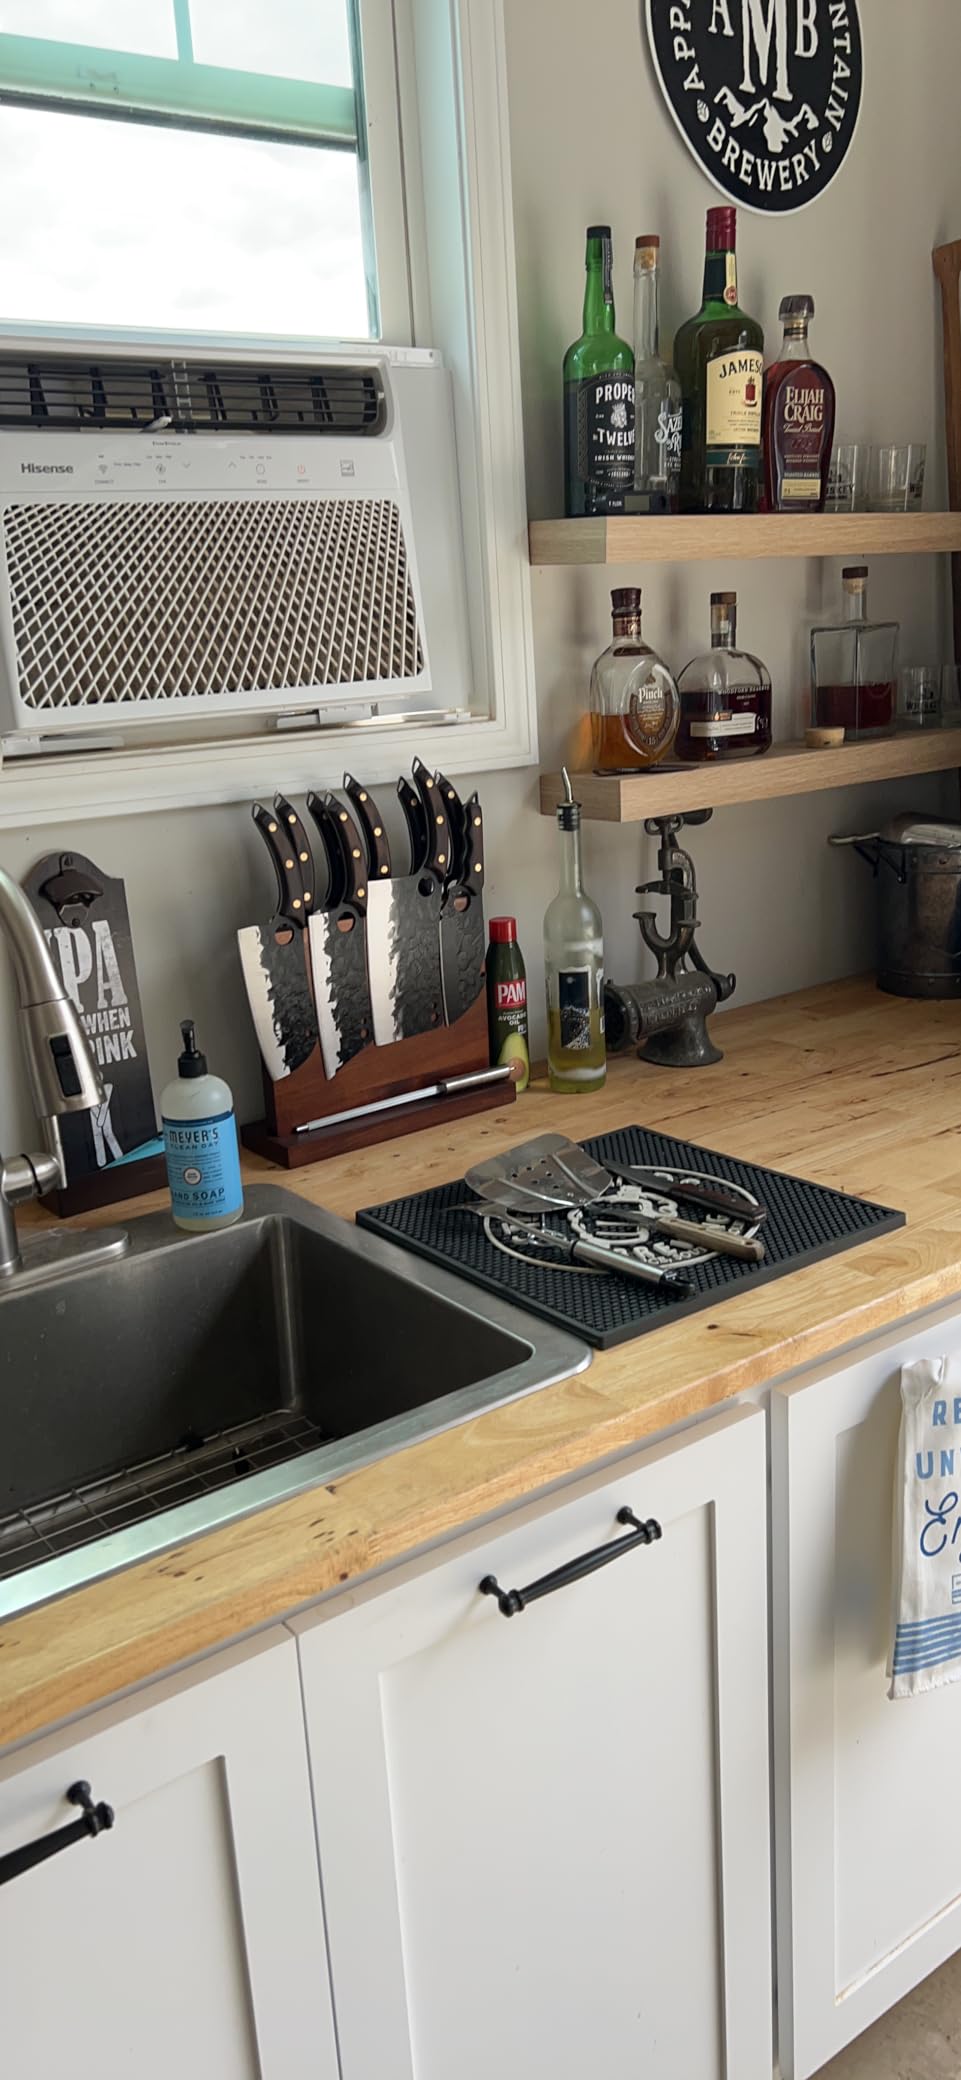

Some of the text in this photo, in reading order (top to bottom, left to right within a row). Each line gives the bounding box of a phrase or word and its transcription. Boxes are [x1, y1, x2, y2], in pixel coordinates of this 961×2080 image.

[670, 0, 706, 91] APP
[706, 118, 820, 191] BREWERY
[785, 386, 824, 406] ELIJAH
[784, 404, 823, 423] CRAIG
[21, 462, 74, 474] Hisense
[638, 687, 663, 704] Pinch
[44, 919, 128, 1014] PA
[497, 980, 526, 1004] PAM
[80, 1007, 131, 1037] WHEN
[88, 1030, 138, 1066] INK
[169, 1127, 219, 1144] MEYER'S
[191, 1187, 225, 1201] SOAP
[916, 1448, 961, 1480] UN
